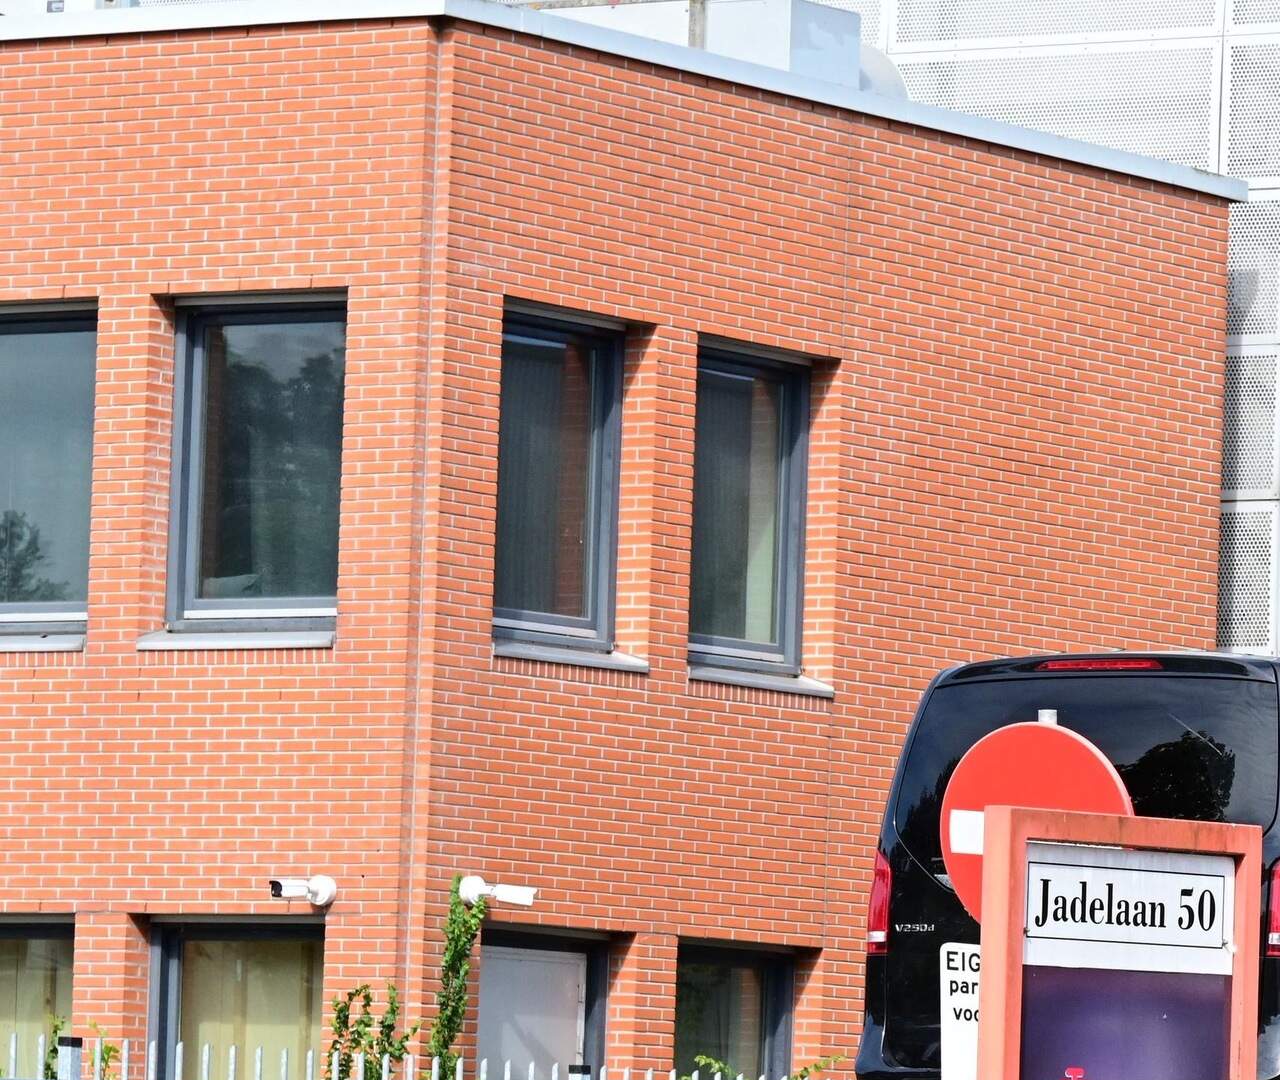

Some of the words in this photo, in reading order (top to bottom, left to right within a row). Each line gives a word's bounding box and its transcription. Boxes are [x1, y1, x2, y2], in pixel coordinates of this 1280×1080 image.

[1034, 878, 1167, 928] Jadelaan
[1177, 887, 1216, 932] 50
[894, 923, 935, 932] V250d
